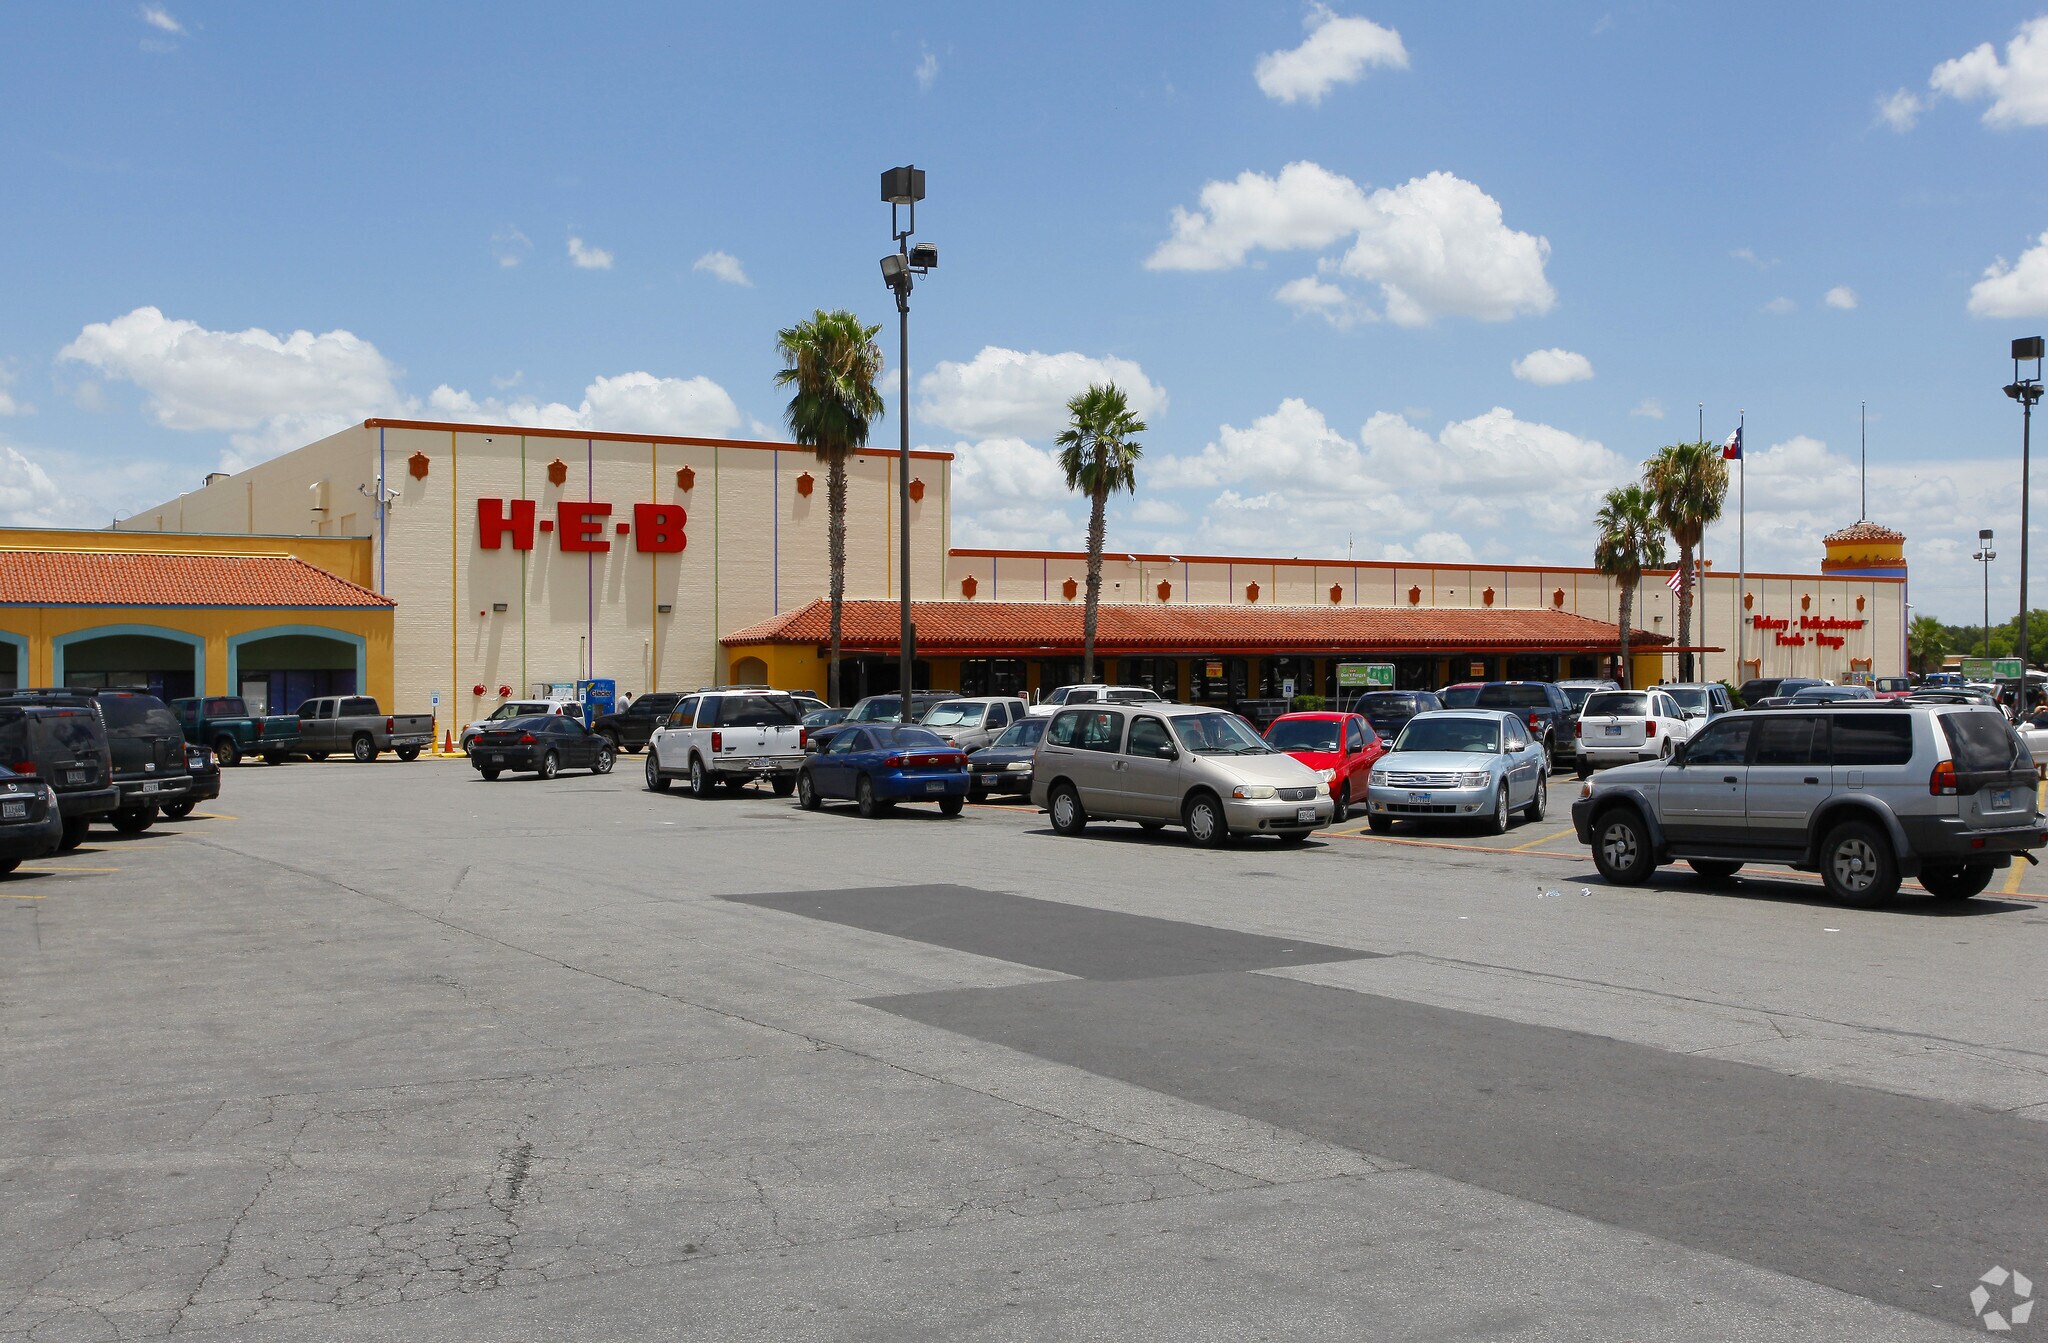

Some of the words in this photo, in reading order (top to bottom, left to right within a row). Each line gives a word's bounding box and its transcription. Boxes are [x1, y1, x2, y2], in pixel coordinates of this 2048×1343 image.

[1753, 615, 1789, 631] Bakery
[1775, 632, 1805, 646] Foods
[1816, 632, 1845, 650] Drugs
